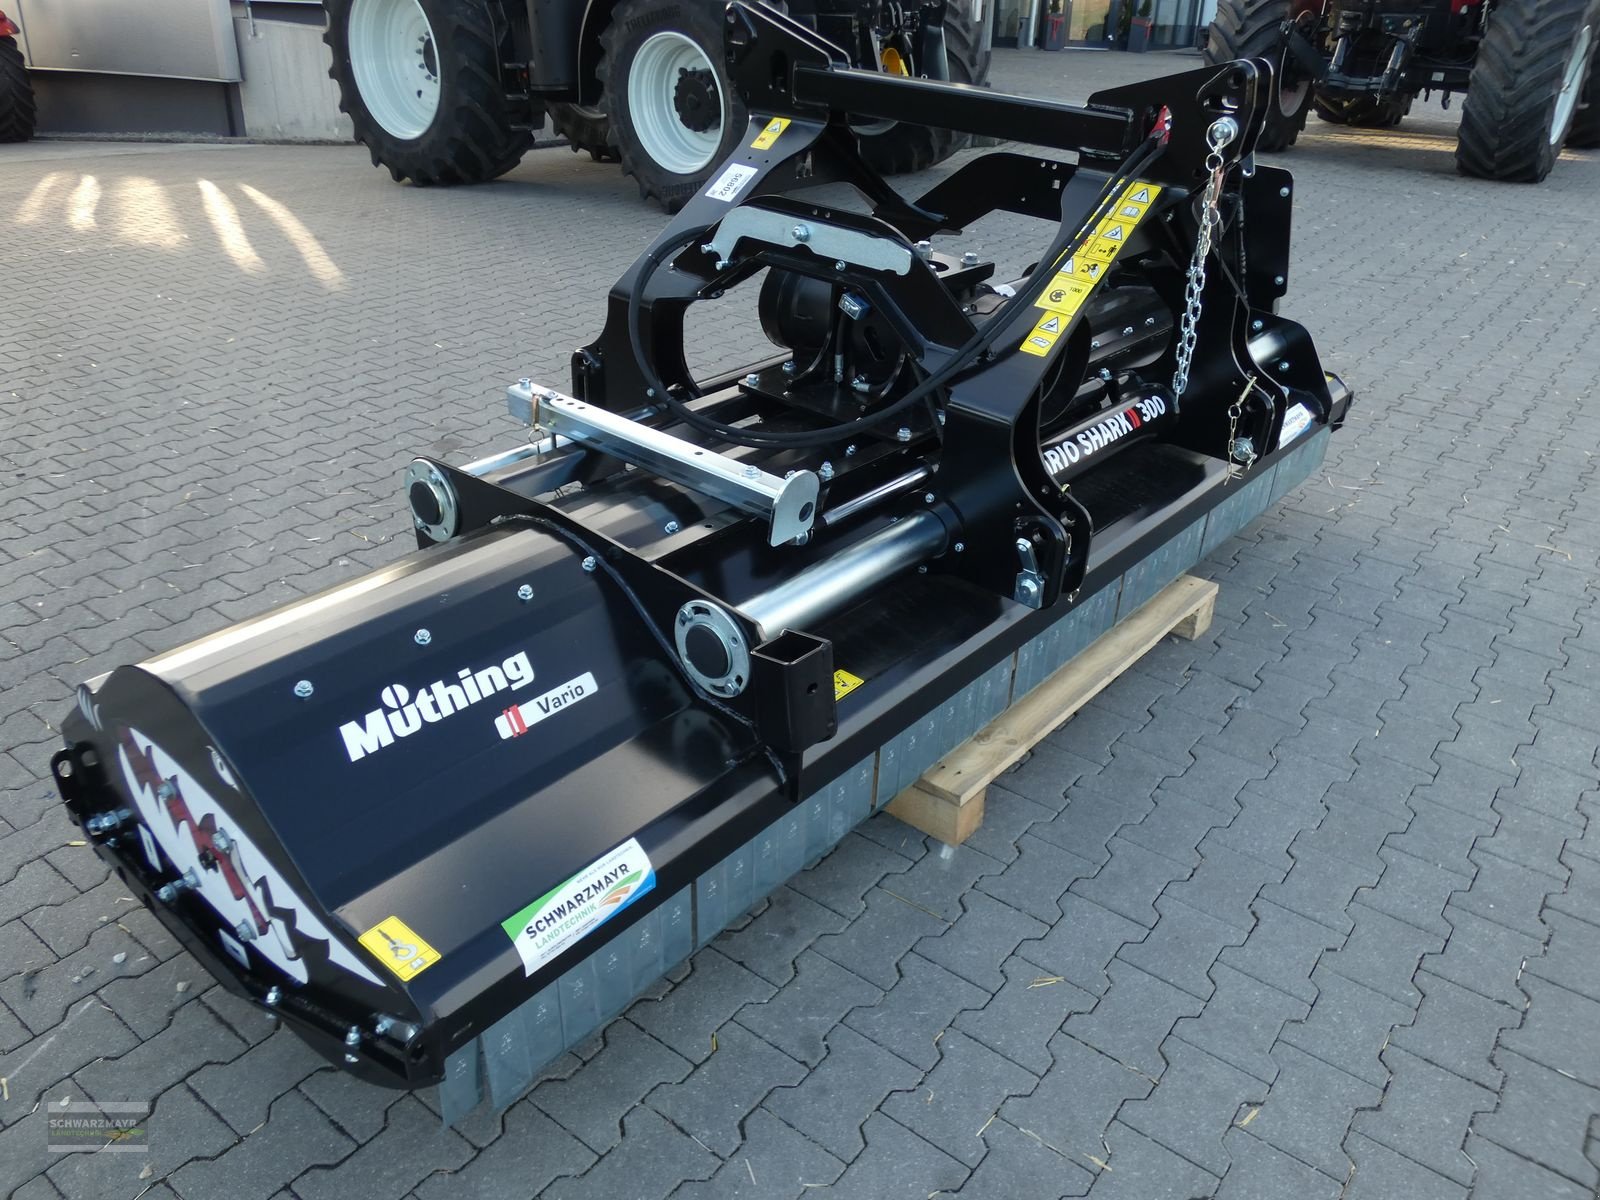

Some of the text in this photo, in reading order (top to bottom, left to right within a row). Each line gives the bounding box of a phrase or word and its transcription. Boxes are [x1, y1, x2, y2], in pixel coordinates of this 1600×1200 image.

[718, 172, 743, 197] 56802
[1043, 395, 1166, 476] RIO SHARK 300
[339, 650, 535, 762] Müthing
[536, 682, 585, 715] Vario
[526, 863, 631, 940] SCHWARZMAYR
[534, 902, 599, 949] LANDTECHNIK
